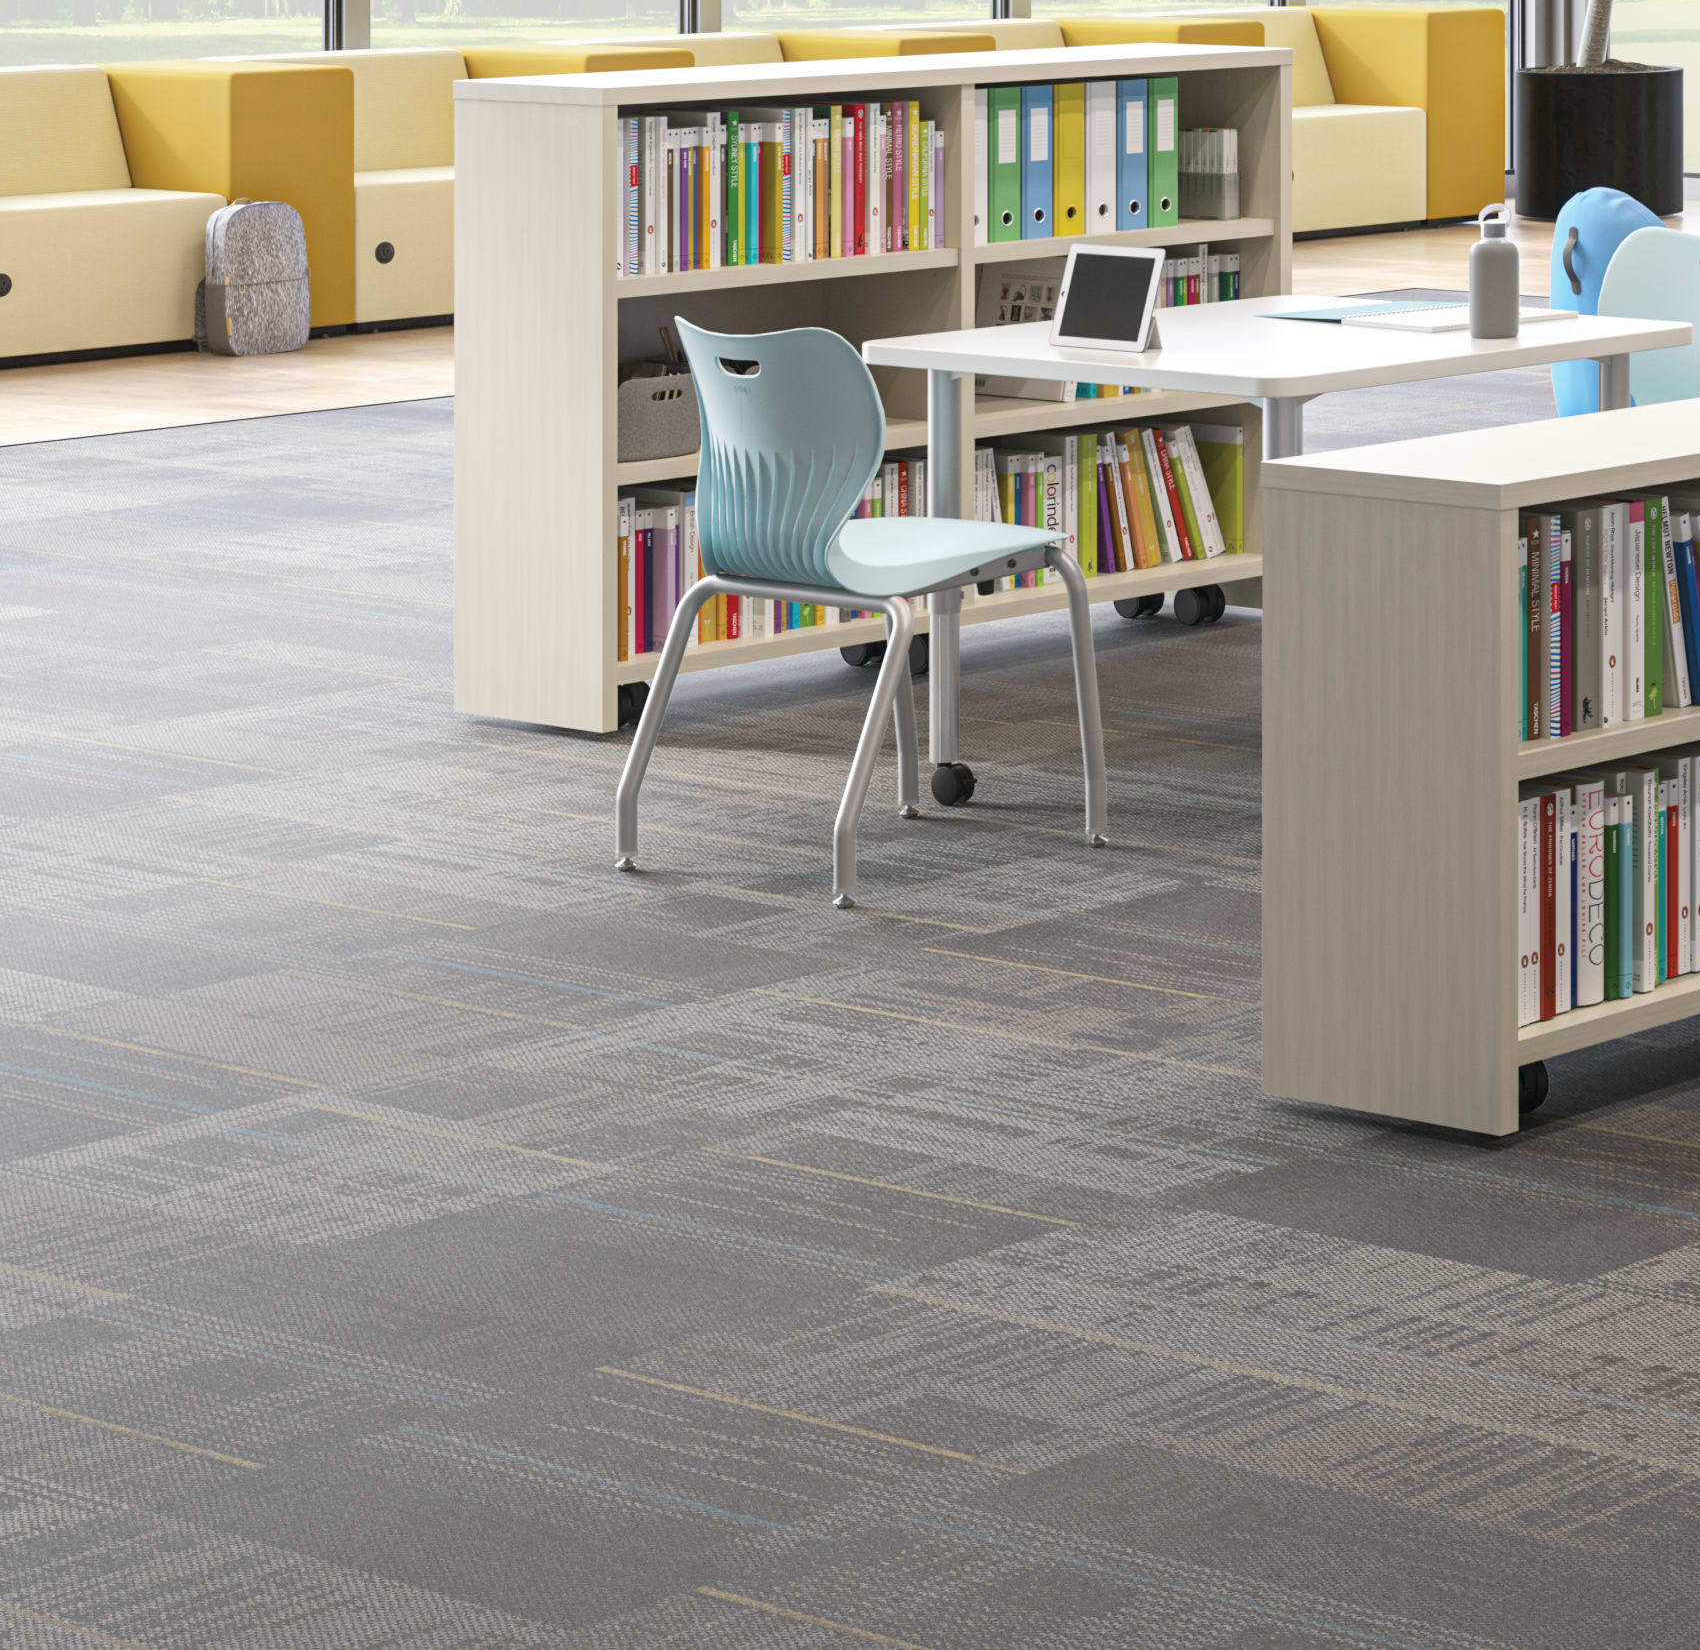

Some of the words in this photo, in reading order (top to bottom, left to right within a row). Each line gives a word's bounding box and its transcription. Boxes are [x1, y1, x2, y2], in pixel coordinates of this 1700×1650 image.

[911, 178, 919, 200] STYLE
[1161, 449, 1170, 470] CHINA
[1166, 470, 1175, 491] STYLE
[1661, 505, 1671, 539] HELMUT
[1633, 528, 1642, 571] Japanese
[1664, 540, 1674, 575] NEWTON
[1531, 551, 1541, 596] MINIMAL
[1633, 572, 1642, 602] Design
[1531, 599, 1541, 633] STYLE
[1669, 581, 1681, 624] Polaroids
[1588, 788, 1606, 966] EURODECO
